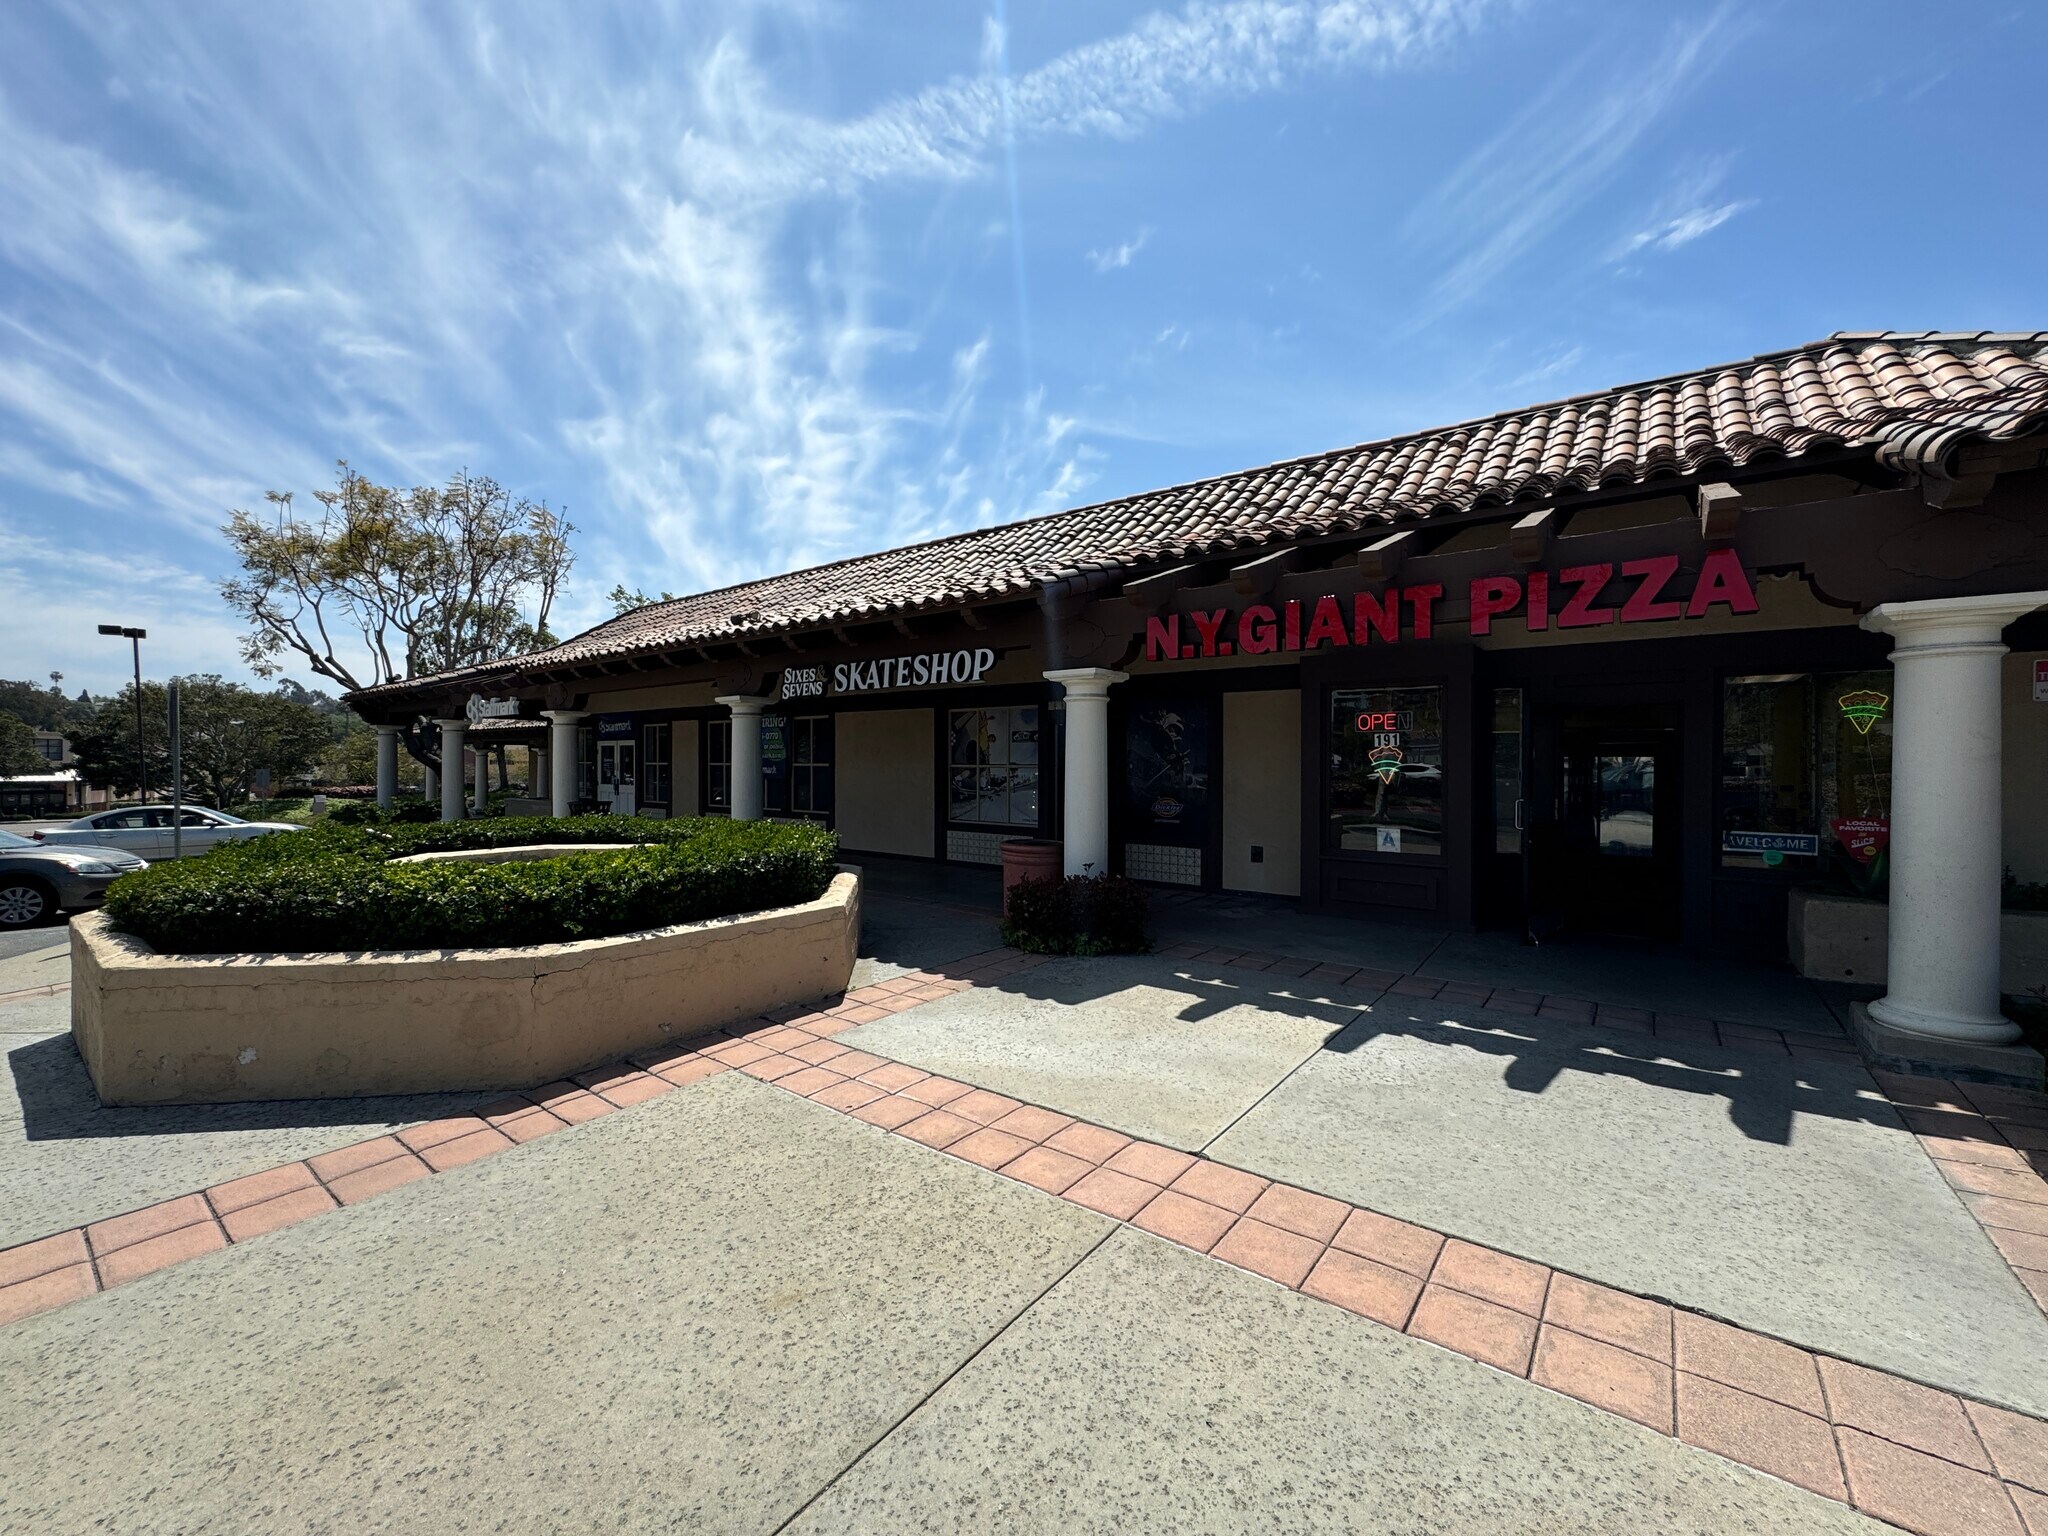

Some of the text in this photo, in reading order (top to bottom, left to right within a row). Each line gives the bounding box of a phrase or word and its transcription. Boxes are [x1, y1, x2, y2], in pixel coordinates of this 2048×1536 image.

[1470, 547, 1759, 636] PIZZA
[784, 664, 828, 684] SIXES &
[834, 648, 994, 692] SKATESHOP
[782, 681, 823, 699] SEVENS
[762, 717, 786, 728] IRING!
[1358, 713, 1409, 730] OPEN
[1376, 734, 1397, 746] 191
[762, 765, 777, 774] mark
[1382, 833, 1396, 847] A
